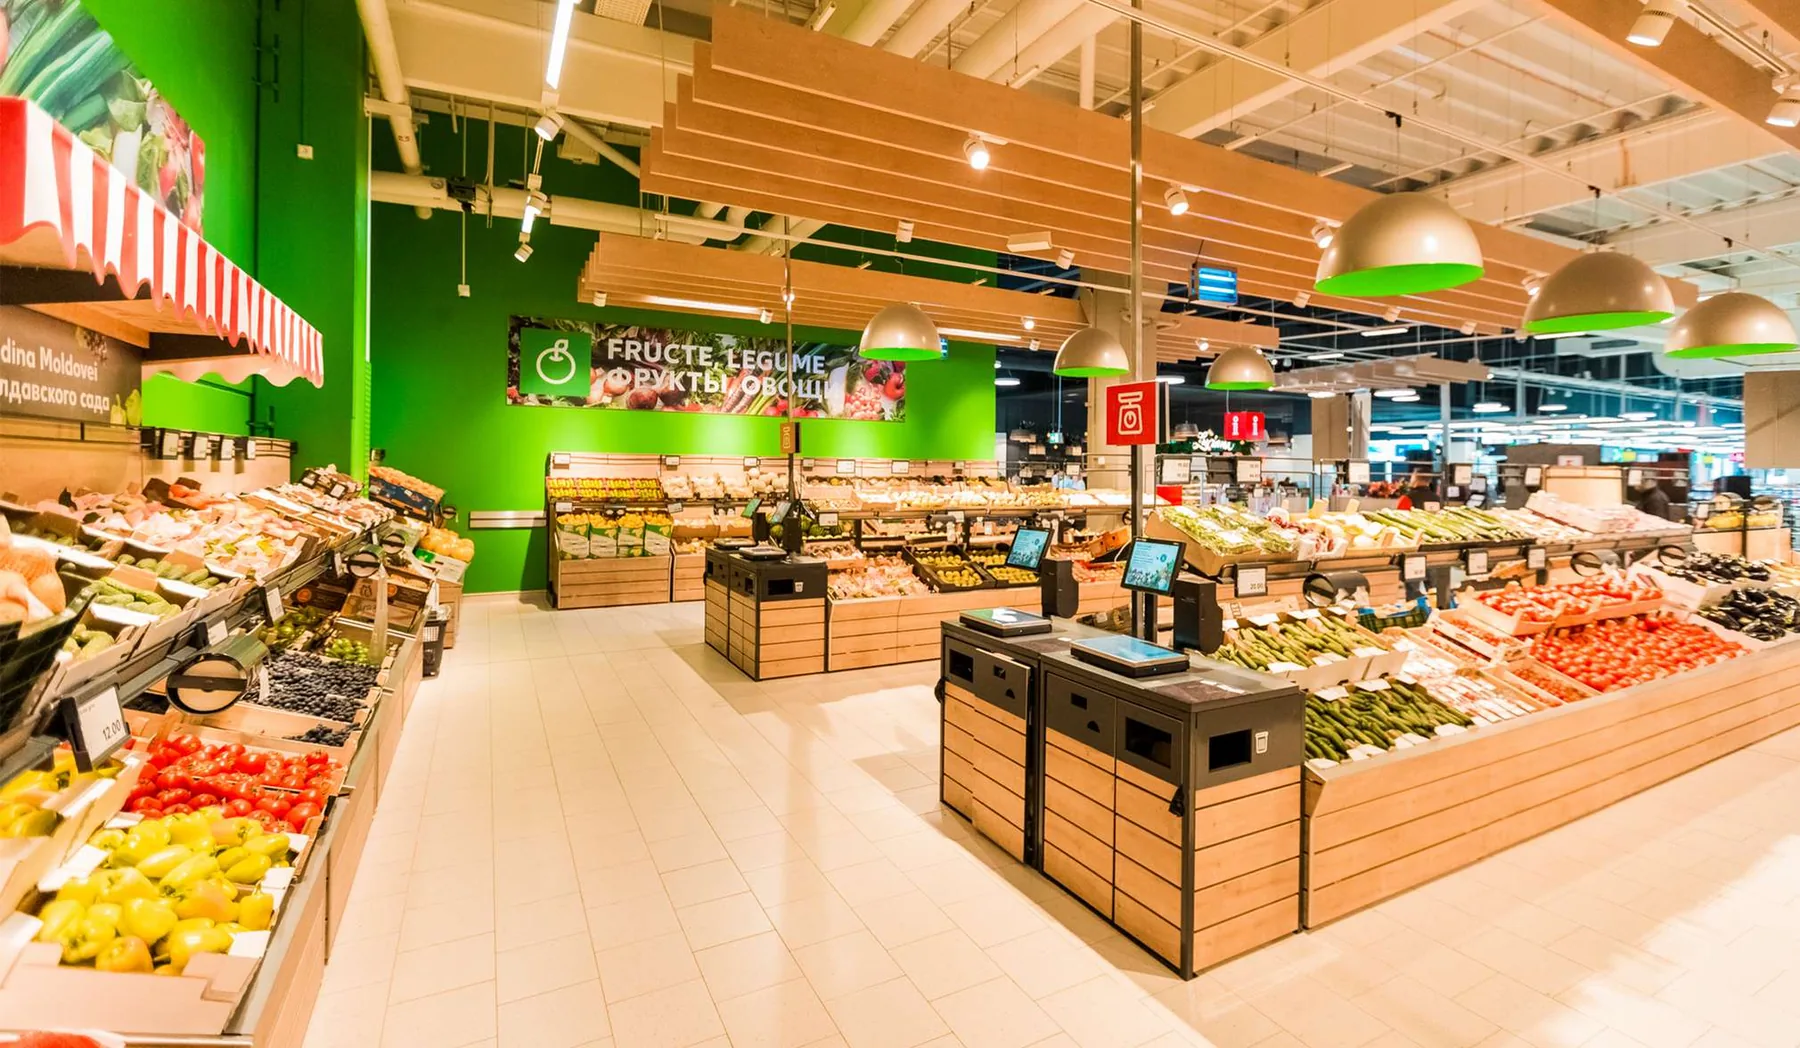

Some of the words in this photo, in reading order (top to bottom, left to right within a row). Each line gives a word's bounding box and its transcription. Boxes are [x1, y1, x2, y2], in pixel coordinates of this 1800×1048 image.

[0, 337, 36, 369] dina
[39, 346, 98, 382] Moldovei
[607, 338, 719, 370] FRUCTE,
[728, 349, 826, 375] LEGUME
[80, 392, 110, 414] сада
[102, 719, 121, 740] 12.00
